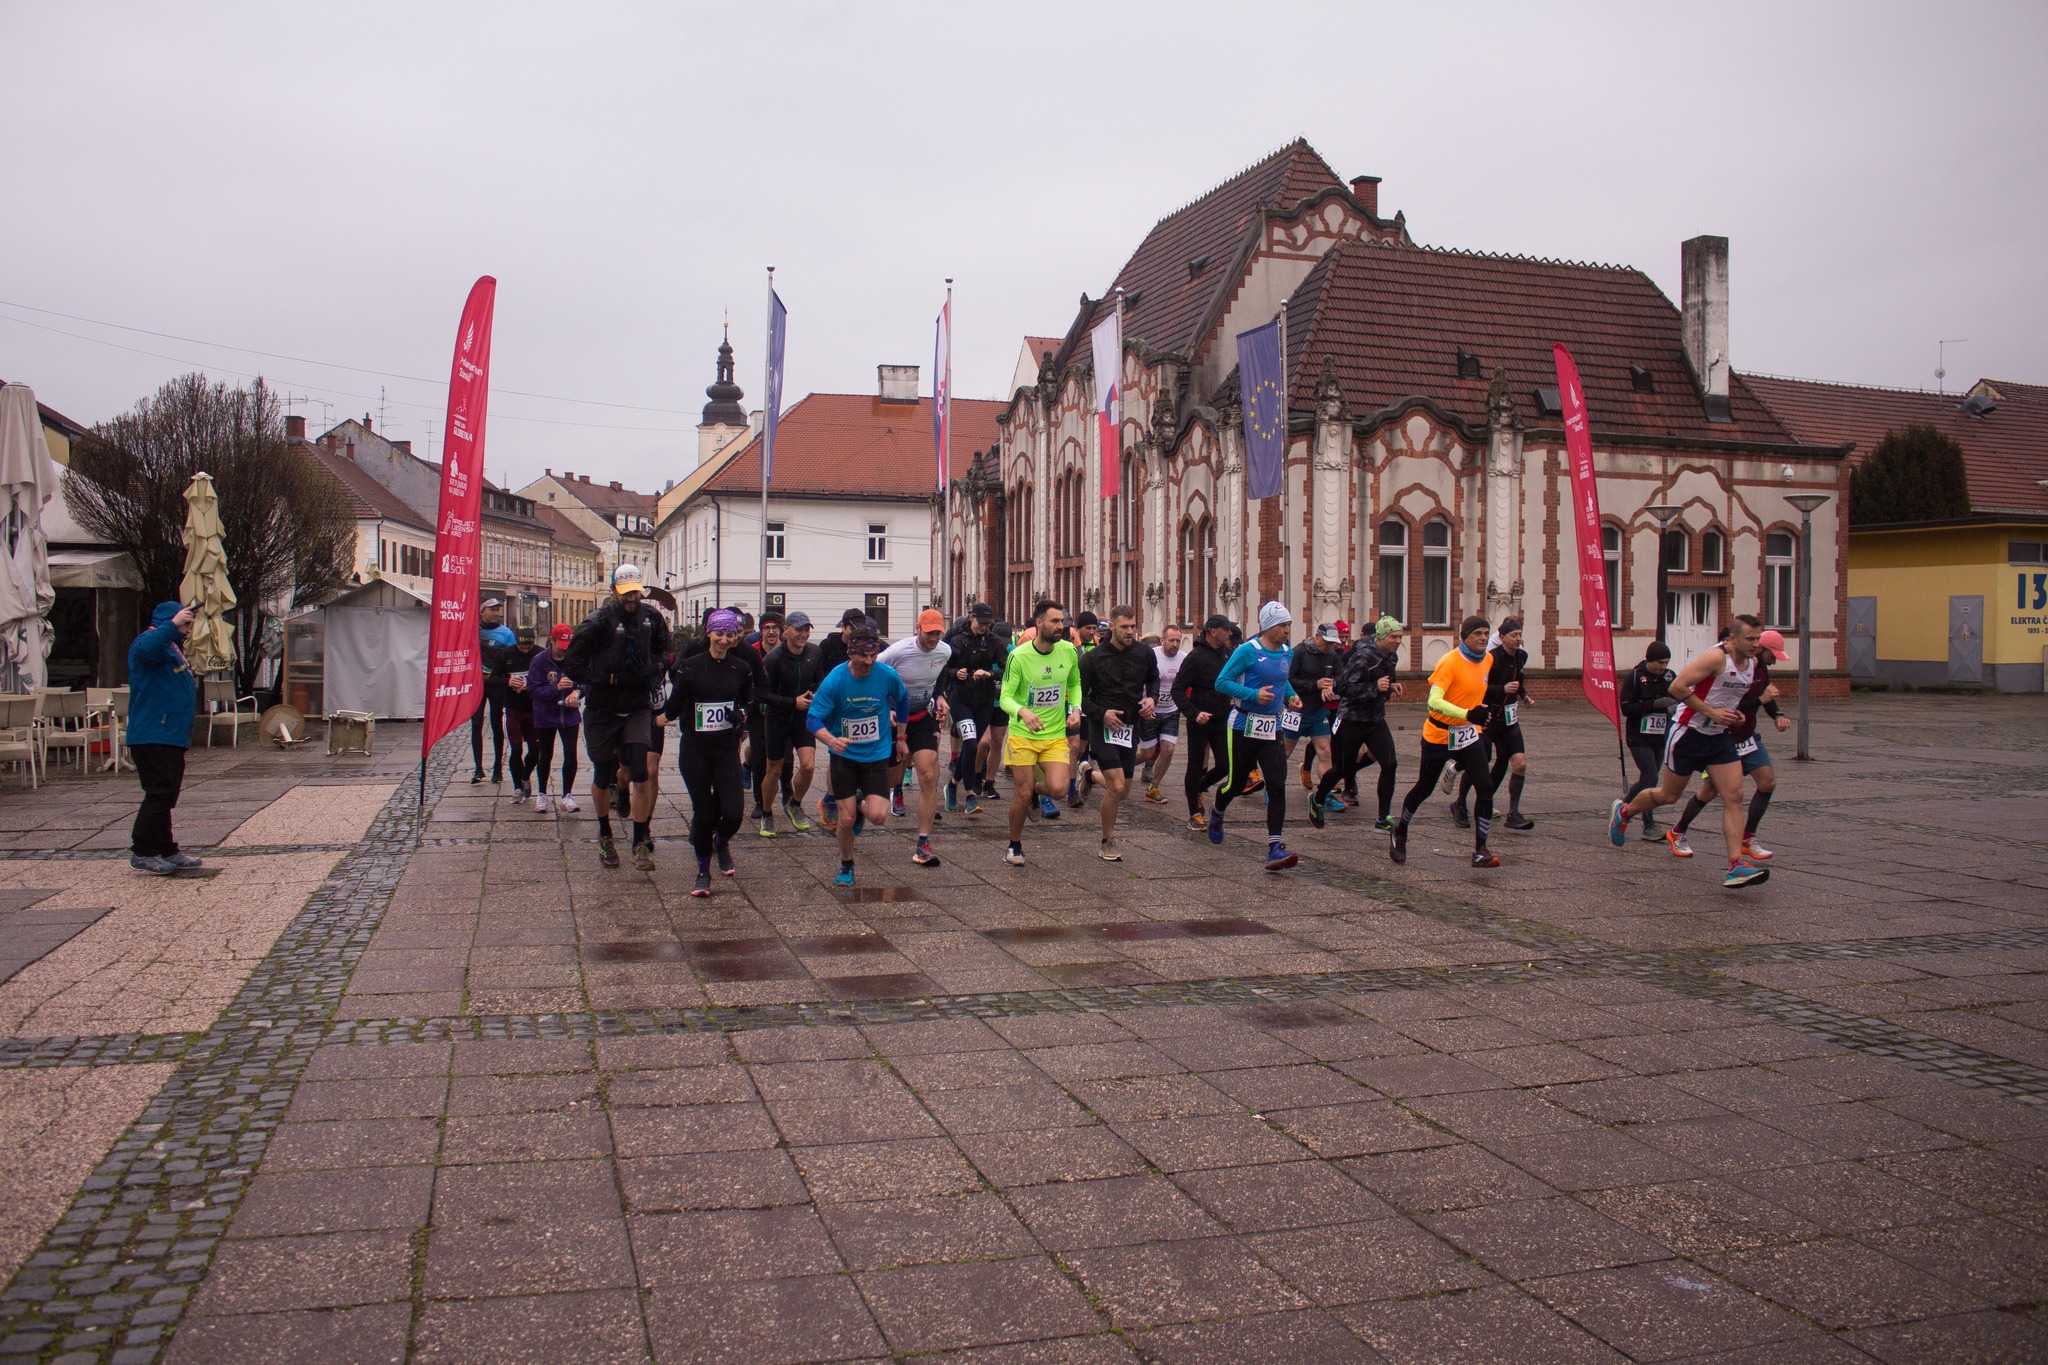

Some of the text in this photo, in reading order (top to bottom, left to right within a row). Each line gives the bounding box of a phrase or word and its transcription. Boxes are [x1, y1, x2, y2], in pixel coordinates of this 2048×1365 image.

[2011, 617, 2041, 625] ELEKTRA
[1037, 689, 1059, 702] 225
[697, 703, 702, 712] 6
[706, 708, 724, 723] 20
[1283, 713, 1299, 726] 216
[852, 721, 877, 736] 203
[1255, 719, 1275, 733] 207
[1649, 717, 1666, 728] 162
[1111, 729, 1130, 741] 202
